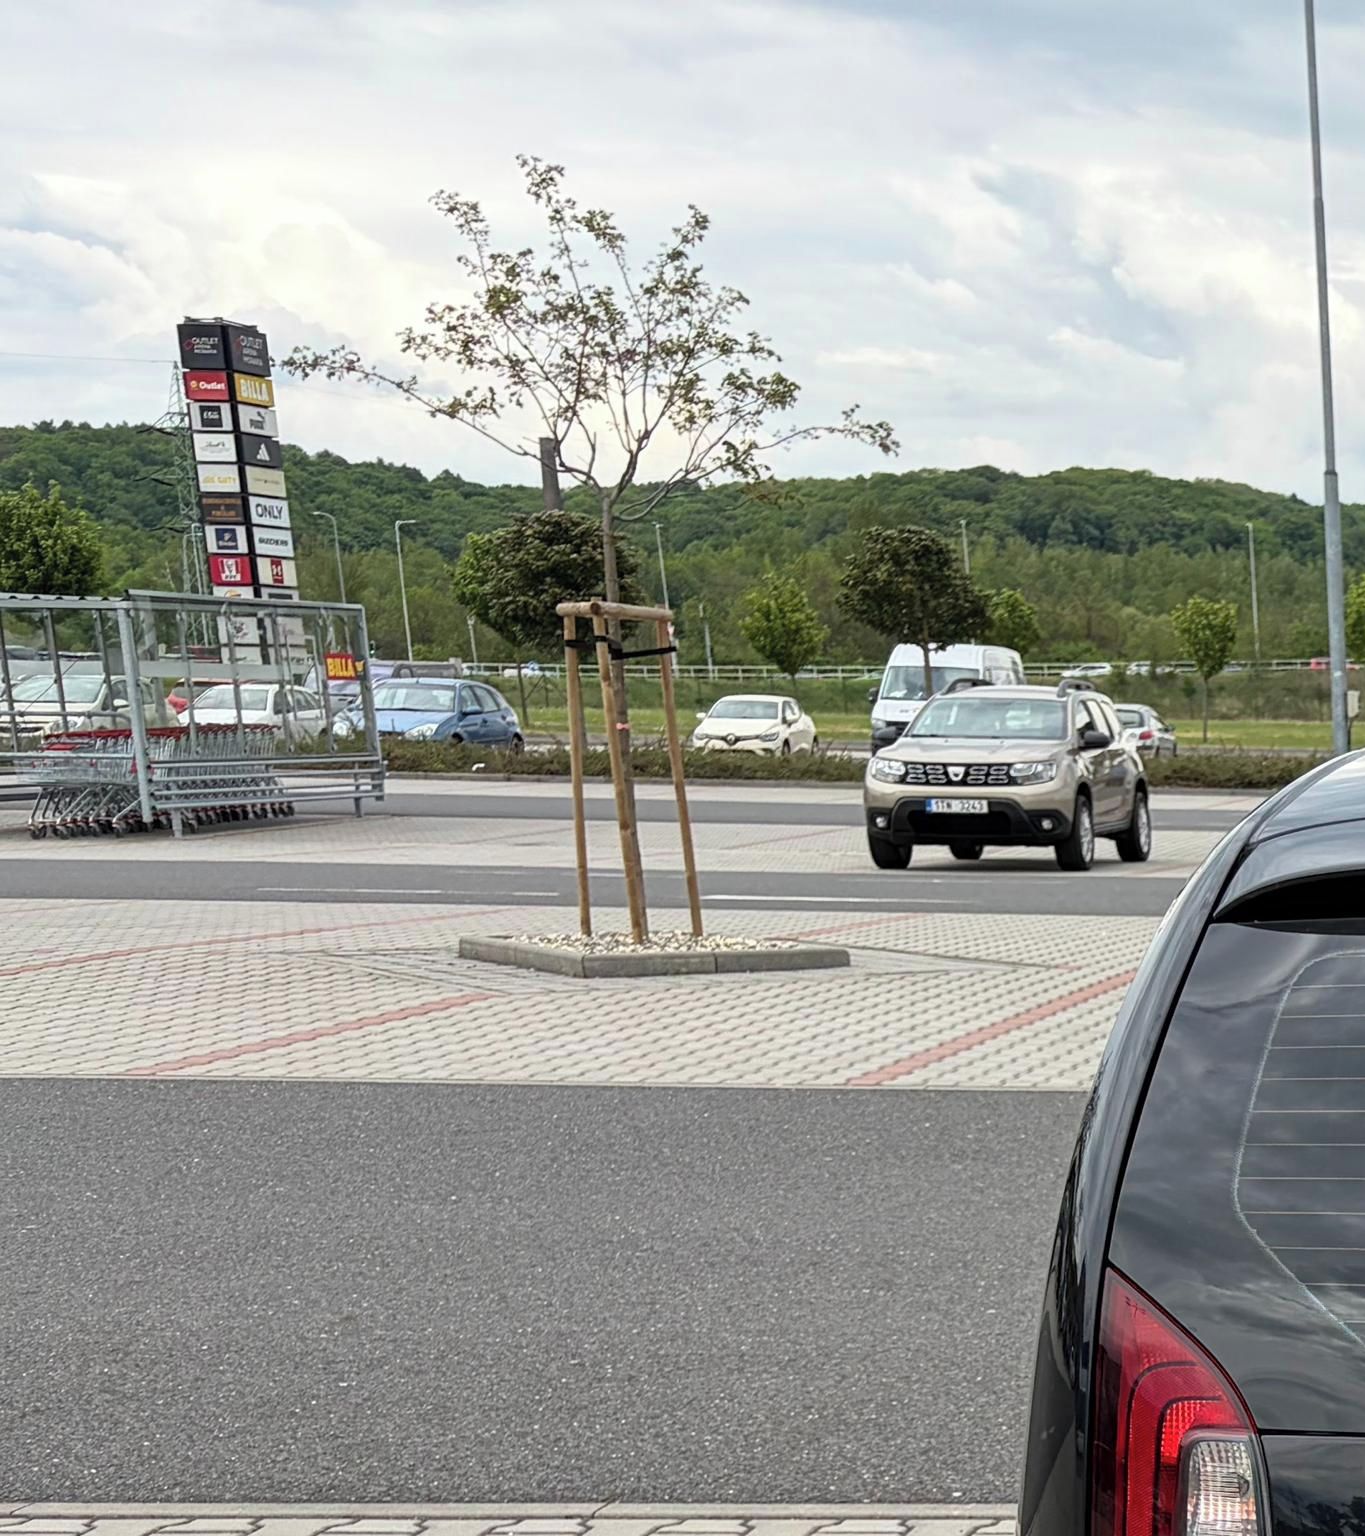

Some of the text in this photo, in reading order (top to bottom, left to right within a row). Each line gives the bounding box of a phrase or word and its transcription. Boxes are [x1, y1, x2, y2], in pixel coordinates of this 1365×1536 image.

[199, 381, 225, 390] Outlet
[240, 379, 270, 401] BILLA
[255, 503, 283, 520] ONLY
[326, 657, 356, 677] BILLA
